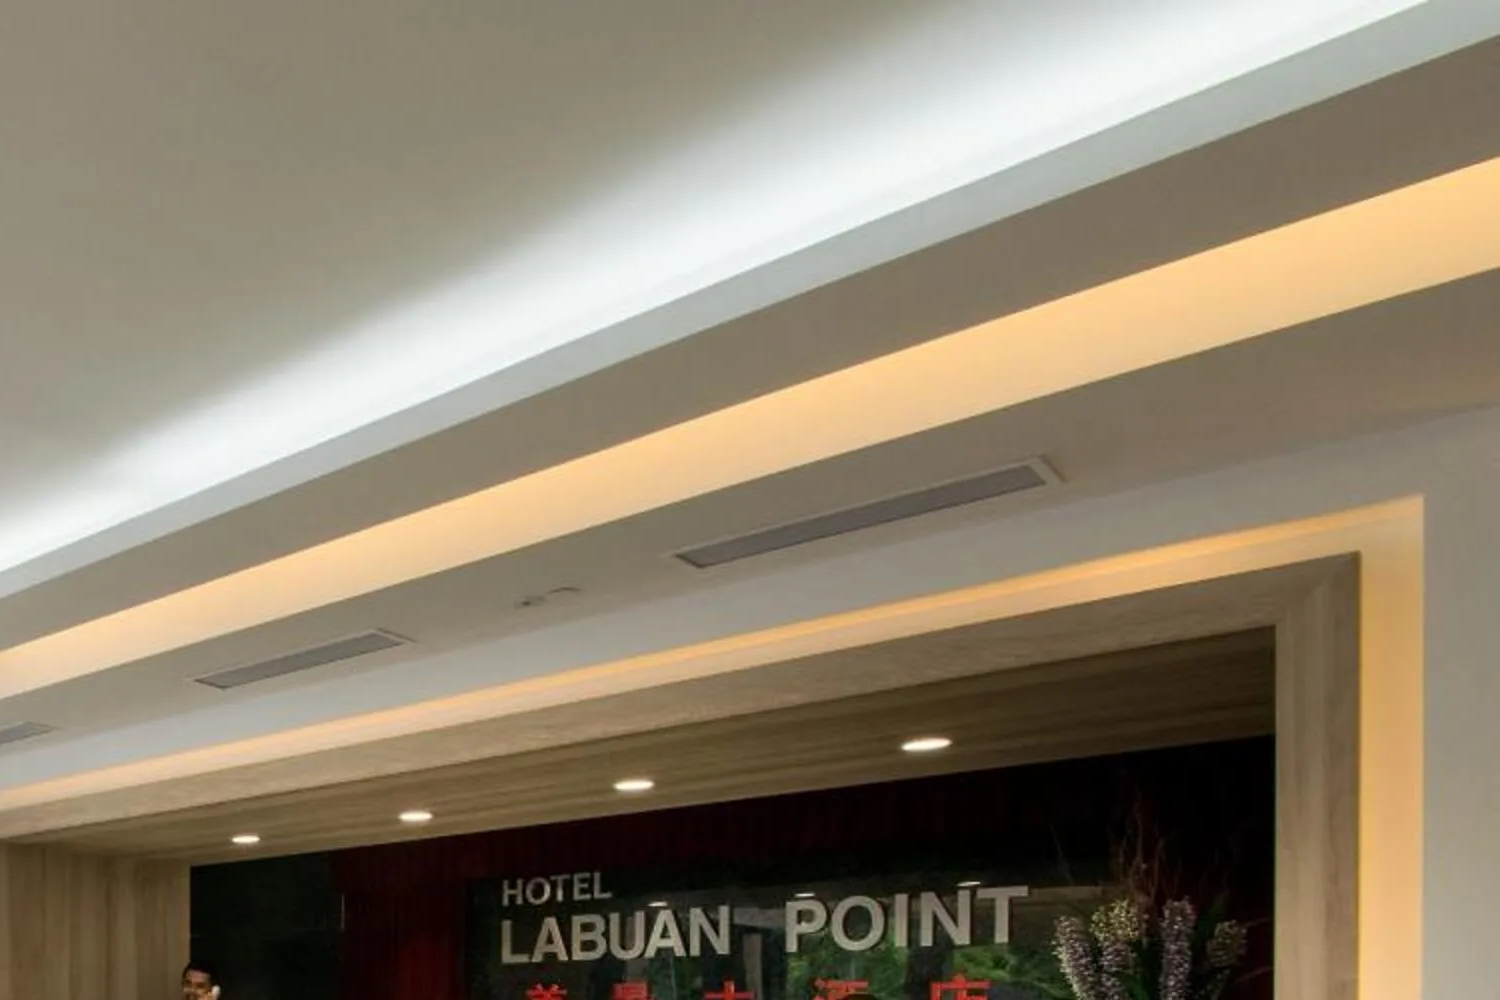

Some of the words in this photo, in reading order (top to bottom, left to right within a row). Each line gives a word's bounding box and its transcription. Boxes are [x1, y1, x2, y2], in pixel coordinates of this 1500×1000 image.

[502, 872, 612, 906] HOTEL
[501, 904, 731, 964] LABUAN
[785, 885, 1029, 953] POINT
